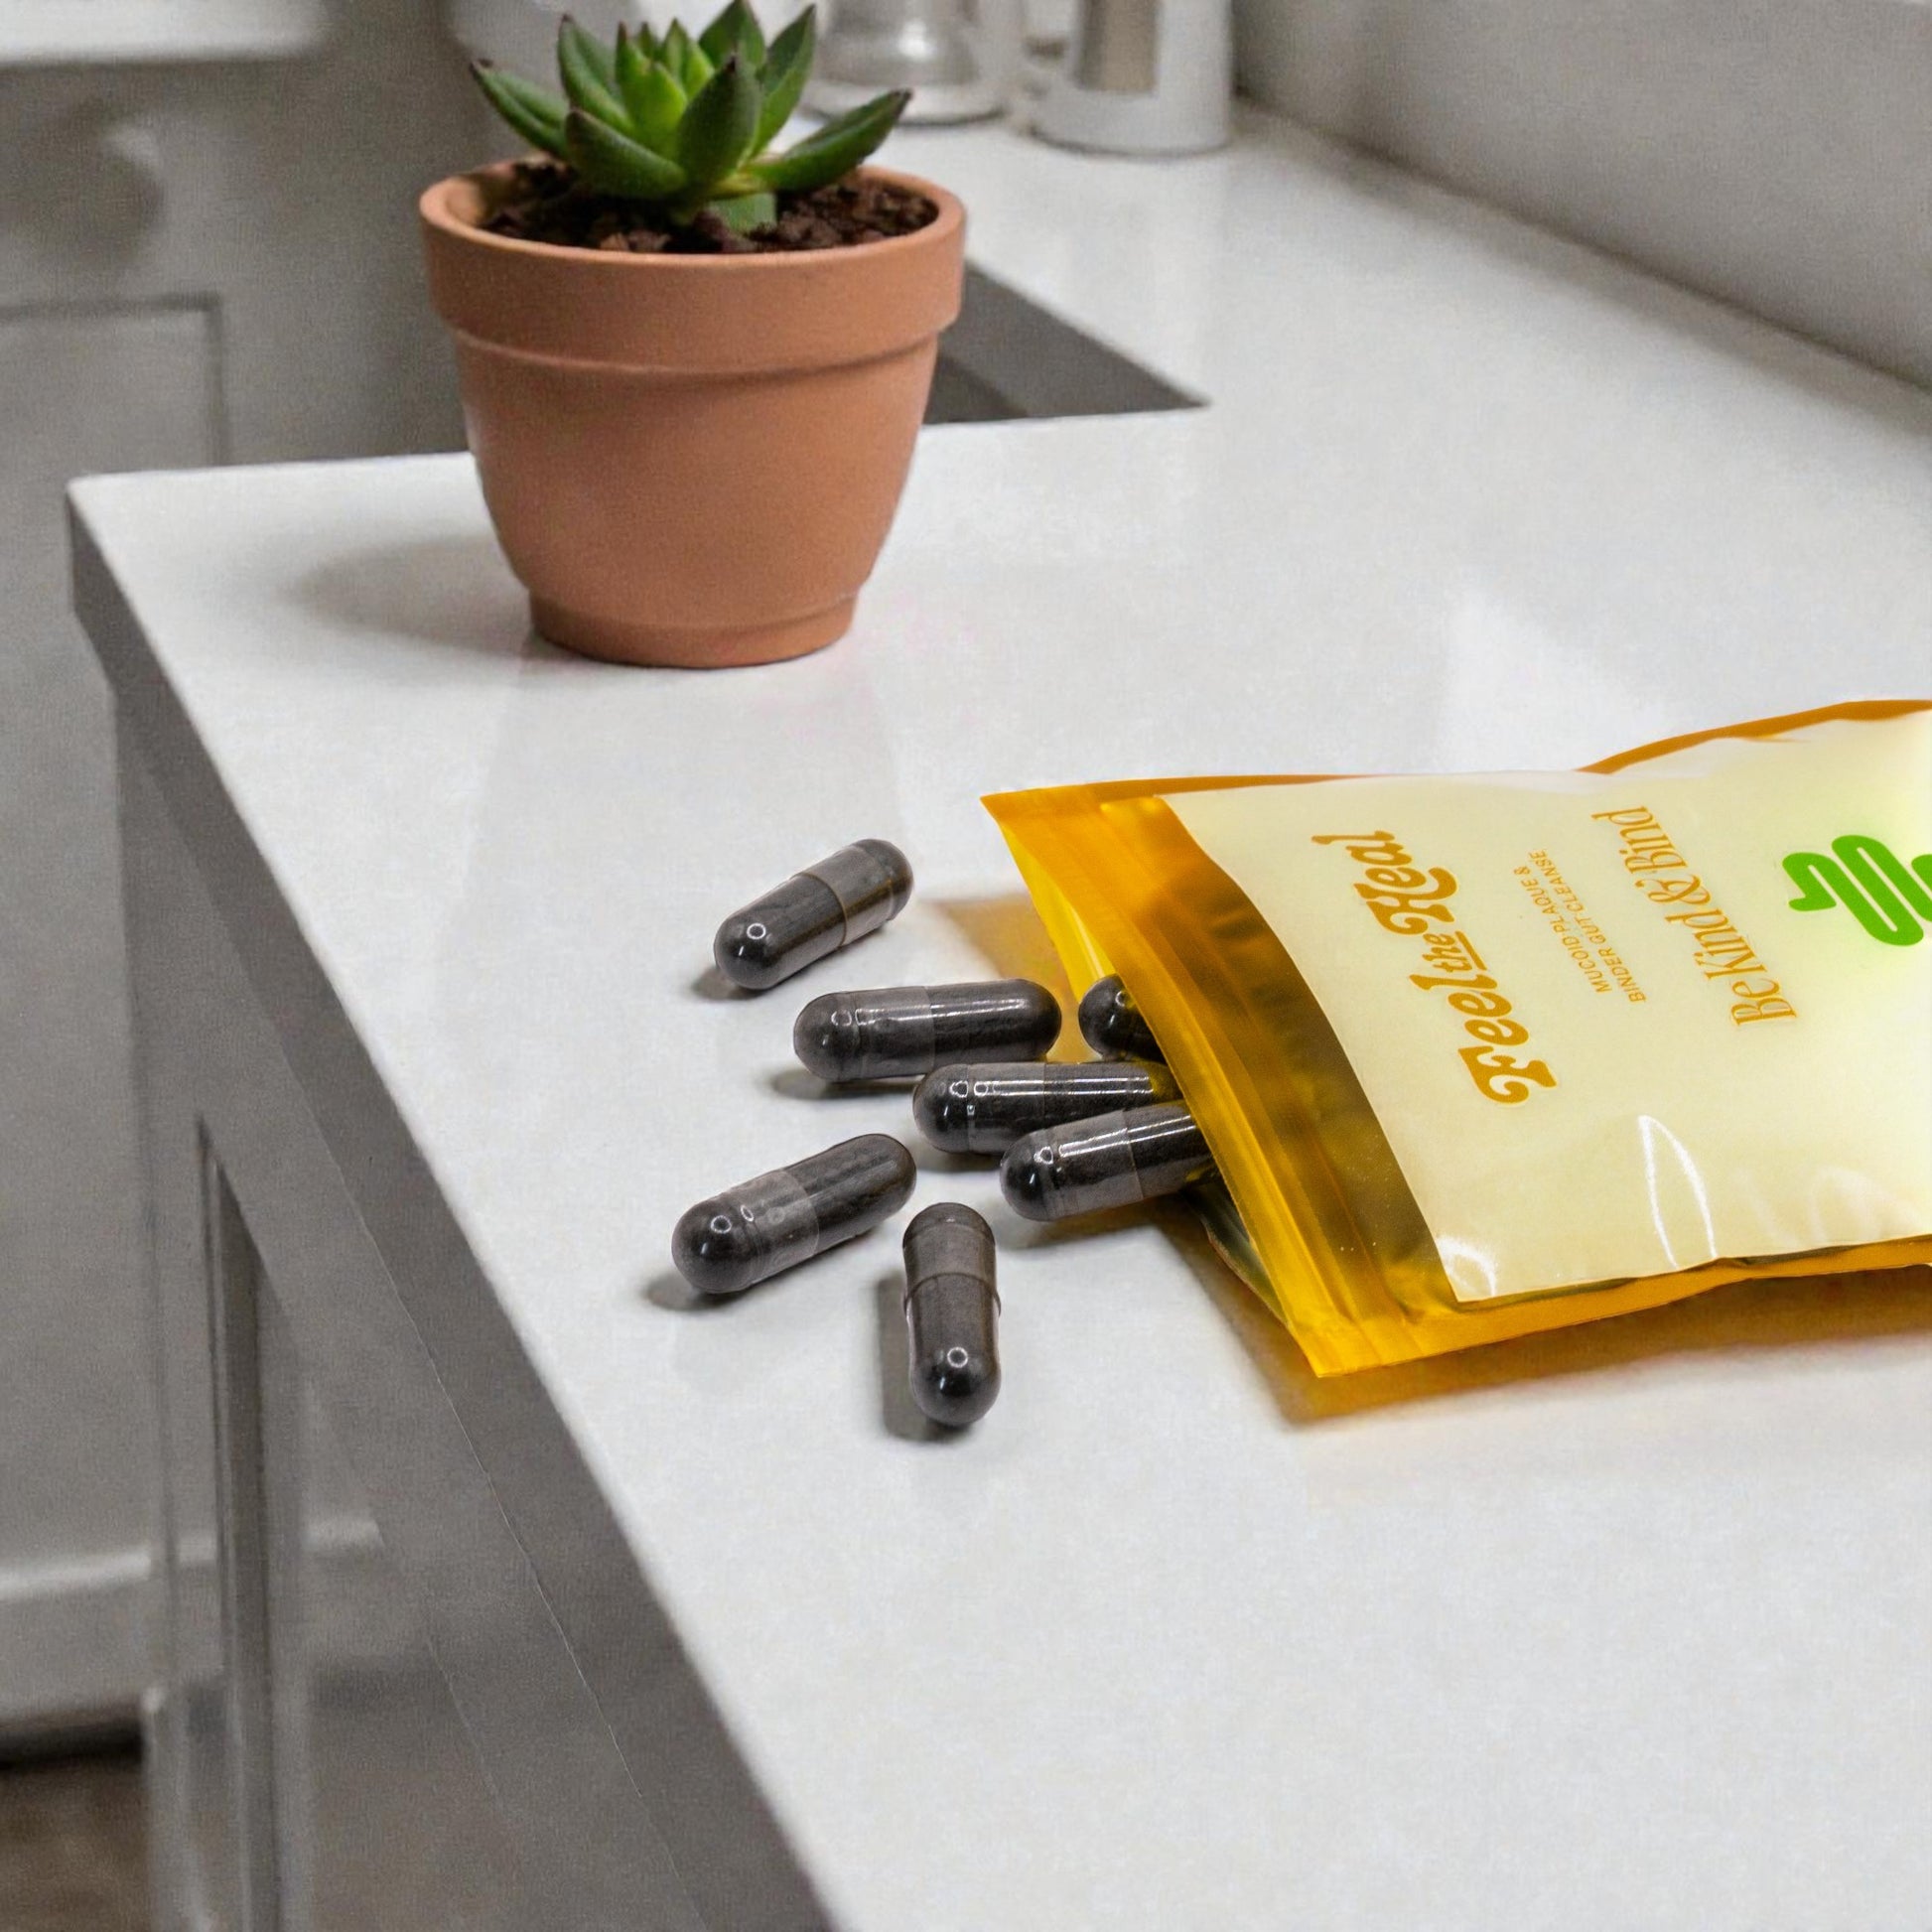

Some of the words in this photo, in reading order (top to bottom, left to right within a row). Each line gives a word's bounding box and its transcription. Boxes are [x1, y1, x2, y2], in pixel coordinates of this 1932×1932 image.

[1590, 806, 1688, 874] Bind
[1311, 830, 1457, 935] Heal
[1513, 866, 1531, 876] &
[1529, 850, 1585, 912] CLEANSE
[1634, 874, 1712, 905] &
[1520, 879, 1570, 933] PLAQUE
[1574, 916, 1606, 944] GUT
[1422, 931, 1475, 973] the
[1561, 935, 1612, 993] MUCOID
[1664, 907, 1767, 980] Kind
[1597, 947, 1646, 1003] BINDER
[1729, 977, 1797, 1026] Be
[1409, 973, 1558, 1104] Feel
